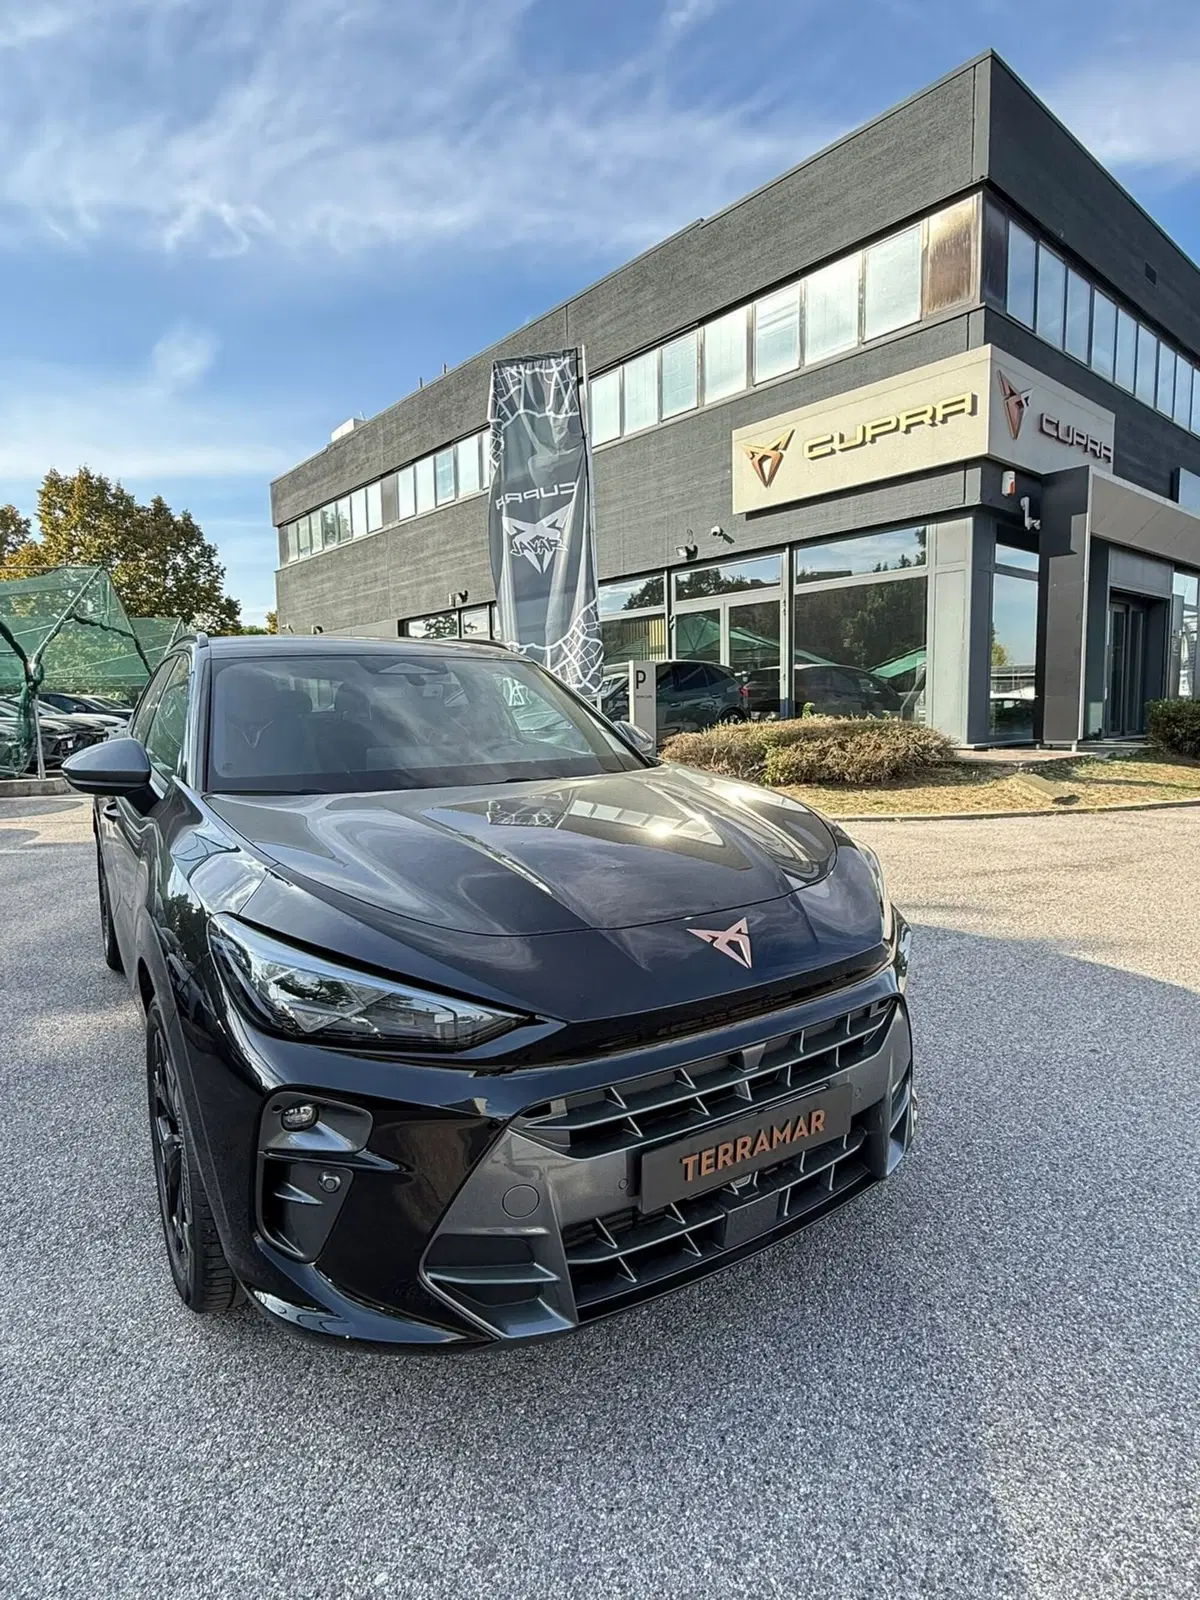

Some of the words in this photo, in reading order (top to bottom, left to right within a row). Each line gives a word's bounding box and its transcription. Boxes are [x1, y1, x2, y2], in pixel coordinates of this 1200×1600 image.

[803, 391, 977, 461] CUPRA
[1040, 412, 1113, 463] CUPRA
[635, 670, 646, 689] P
[680, 1109, 826, 1182] TERRAMAR
